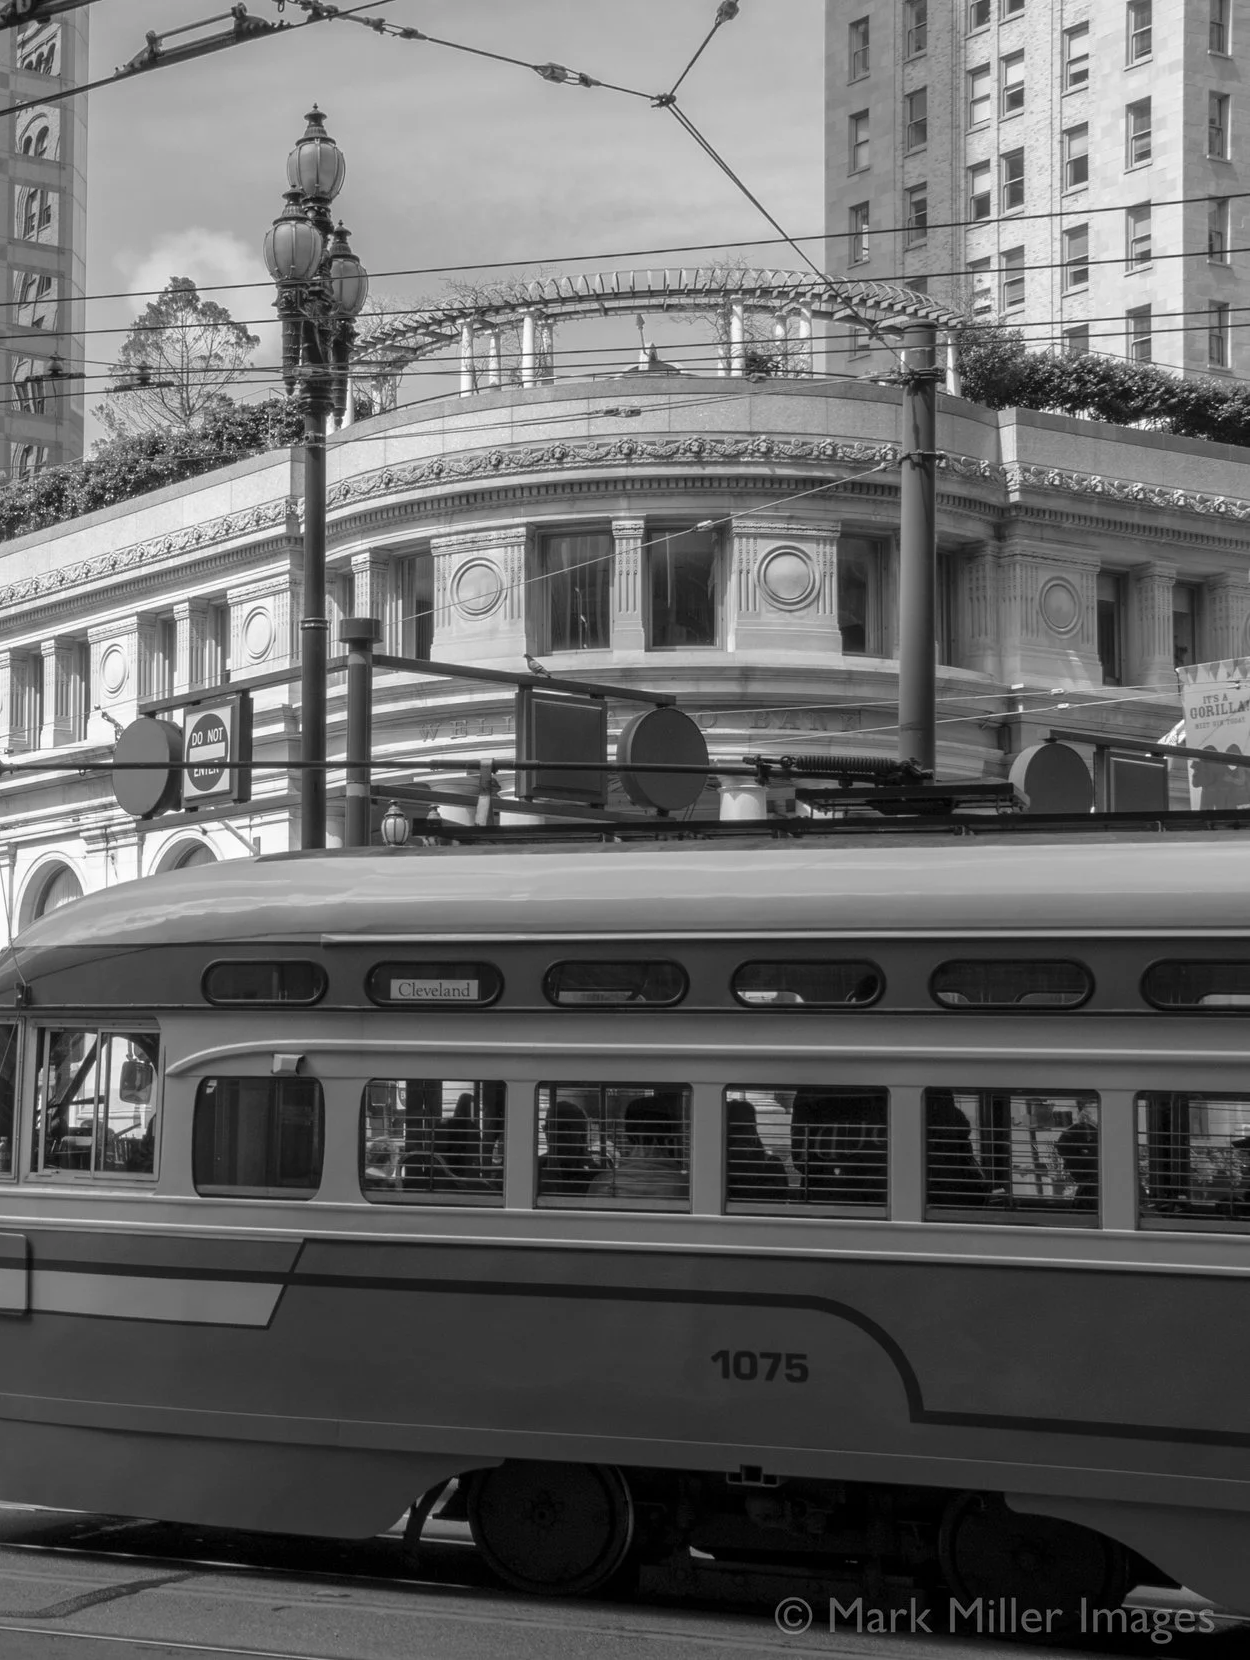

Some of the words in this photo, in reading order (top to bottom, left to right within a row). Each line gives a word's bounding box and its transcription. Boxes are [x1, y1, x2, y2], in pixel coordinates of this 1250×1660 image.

[1222, 692, 1228, 701] A
[192, 732, 203, 746] DO
[207, 727, 224, 743] NOT
[418, 716, 516, 742] WELL
[398, 982, 470, 998] Cleveland
[711, 1350, 809, 1383] 1075
